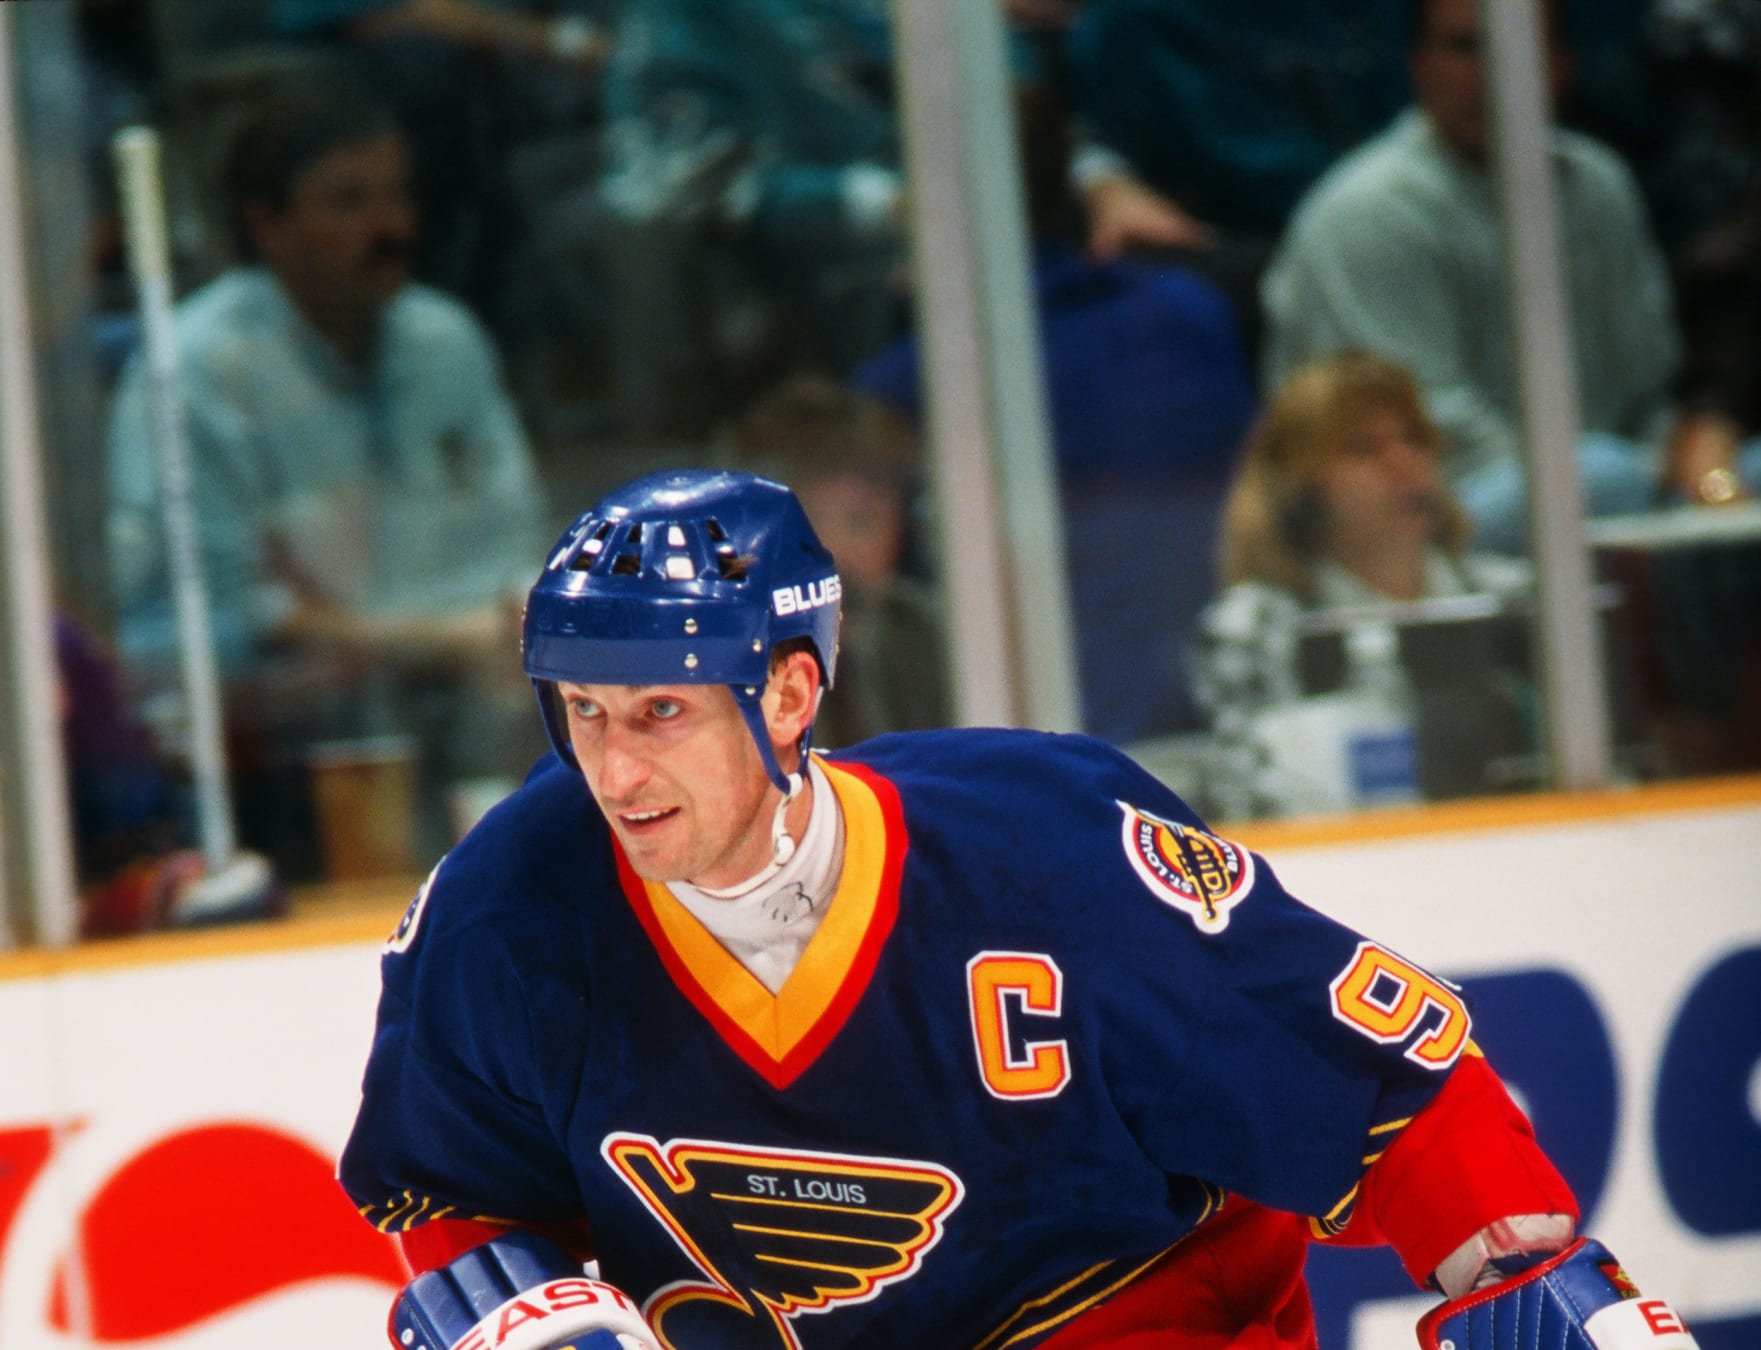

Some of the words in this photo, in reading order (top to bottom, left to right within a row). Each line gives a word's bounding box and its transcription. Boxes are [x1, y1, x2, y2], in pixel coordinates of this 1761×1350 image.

[1140, 823, 1168, 876] LOUIS
[966, 950, 1072, 1100] C
[747, 1174, 786, 1197] ST.
[794, 1179, 867, 1204] LOUIS
[1636, 1299, 1689, 1336] E
